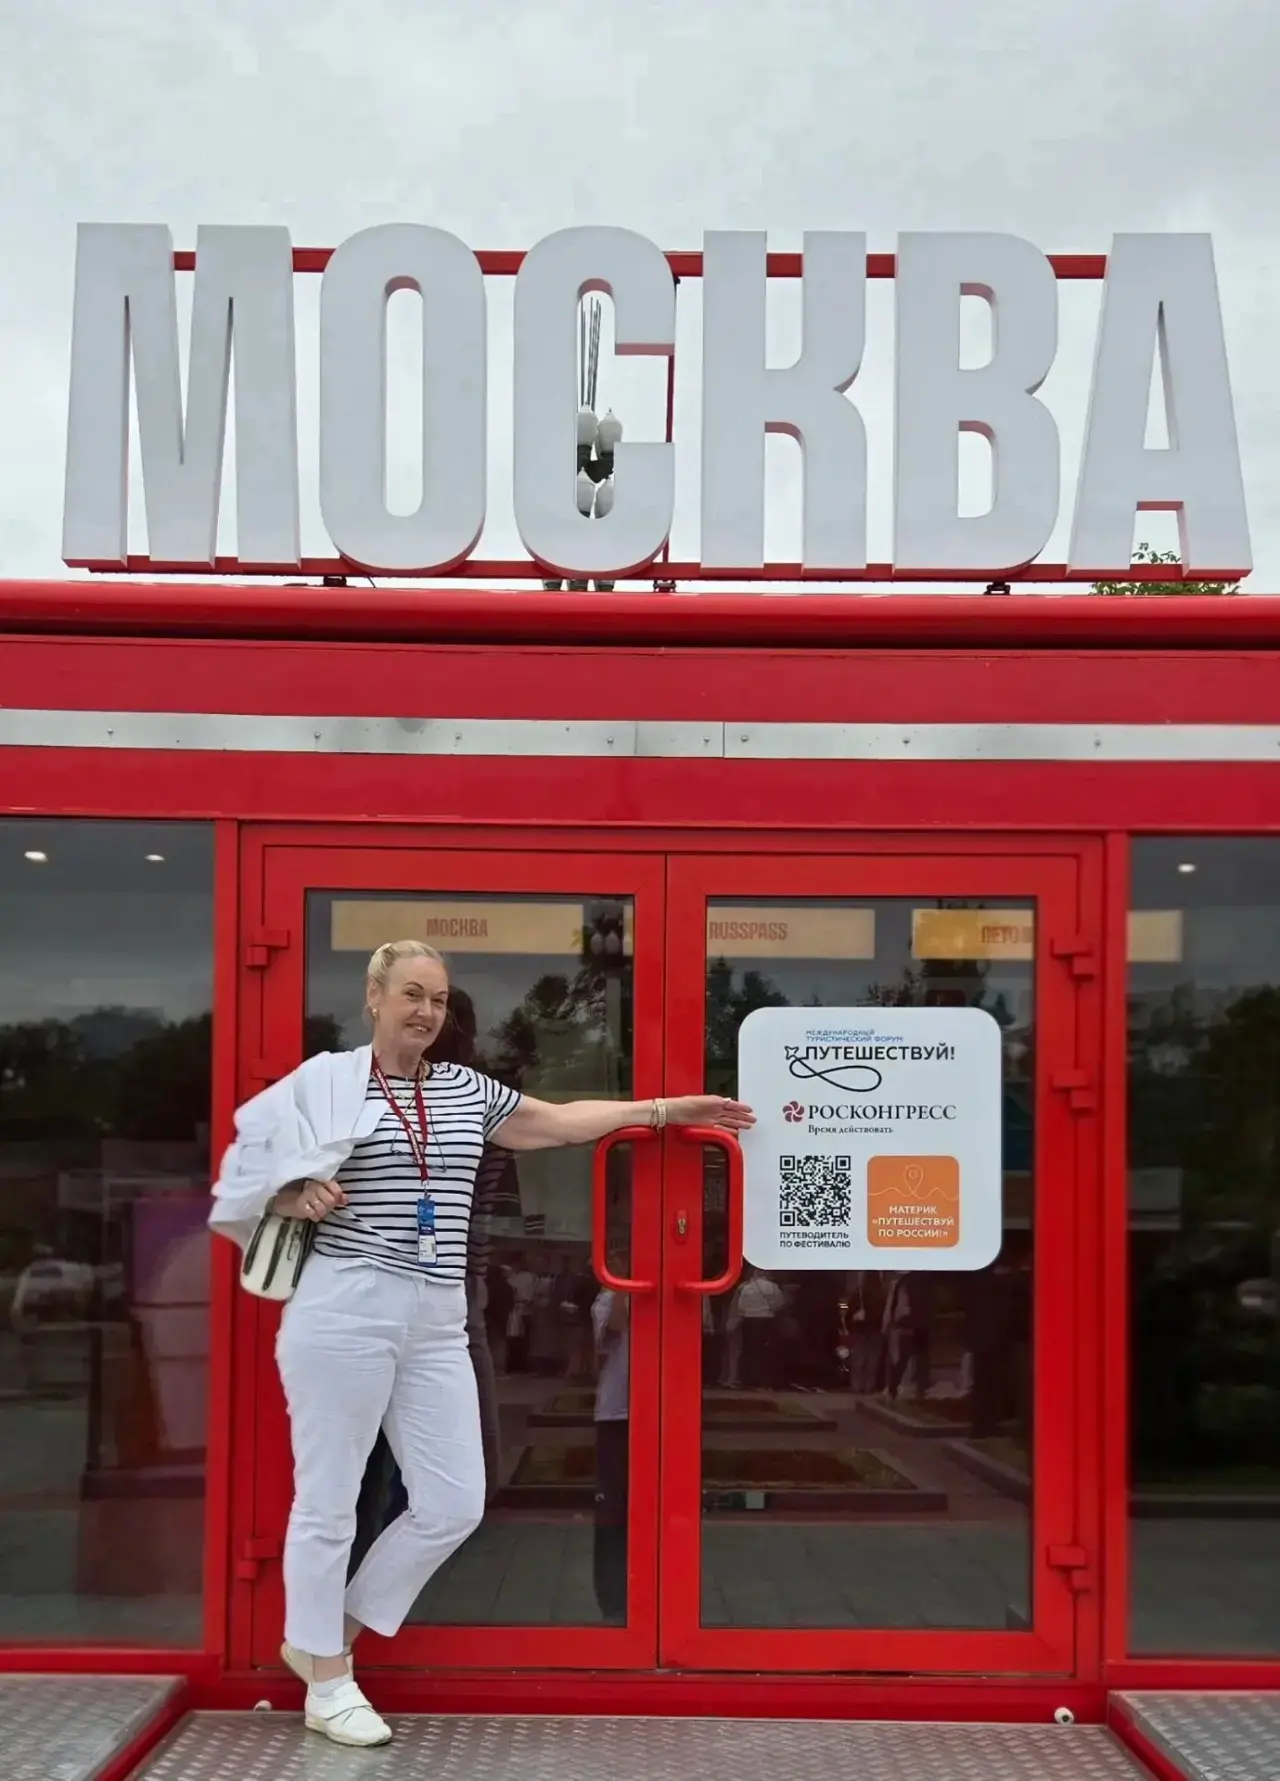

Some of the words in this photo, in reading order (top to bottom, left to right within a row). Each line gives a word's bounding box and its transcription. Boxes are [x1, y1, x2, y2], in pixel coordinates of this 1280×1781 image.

[62, 222, 1252, 576] МОСКВА
[426, 918, 488, 937] МОСКВА
[708, 921, 788, 940] RUSSPASS
[803, 1042, 955, 1061] ПУТЕШЕСТВУЙ!
[808, 1104, 957, 1120] РОСКОНГРЕСС
[808, 1124, 837, 1135] Время
[838, 1125, 894, 1134] действовать
[889, 1205, 937, 1215] МАТЕРИК
[779, 1231, 850, 1240] ПУТЕВОДИТЕЛЬ
[878, 1229, 894, 1238] ПО
[779, 1240, 793, 1248] ПО
[793, 1240, 851, 1248] ФЕСТИВАЛЮ
